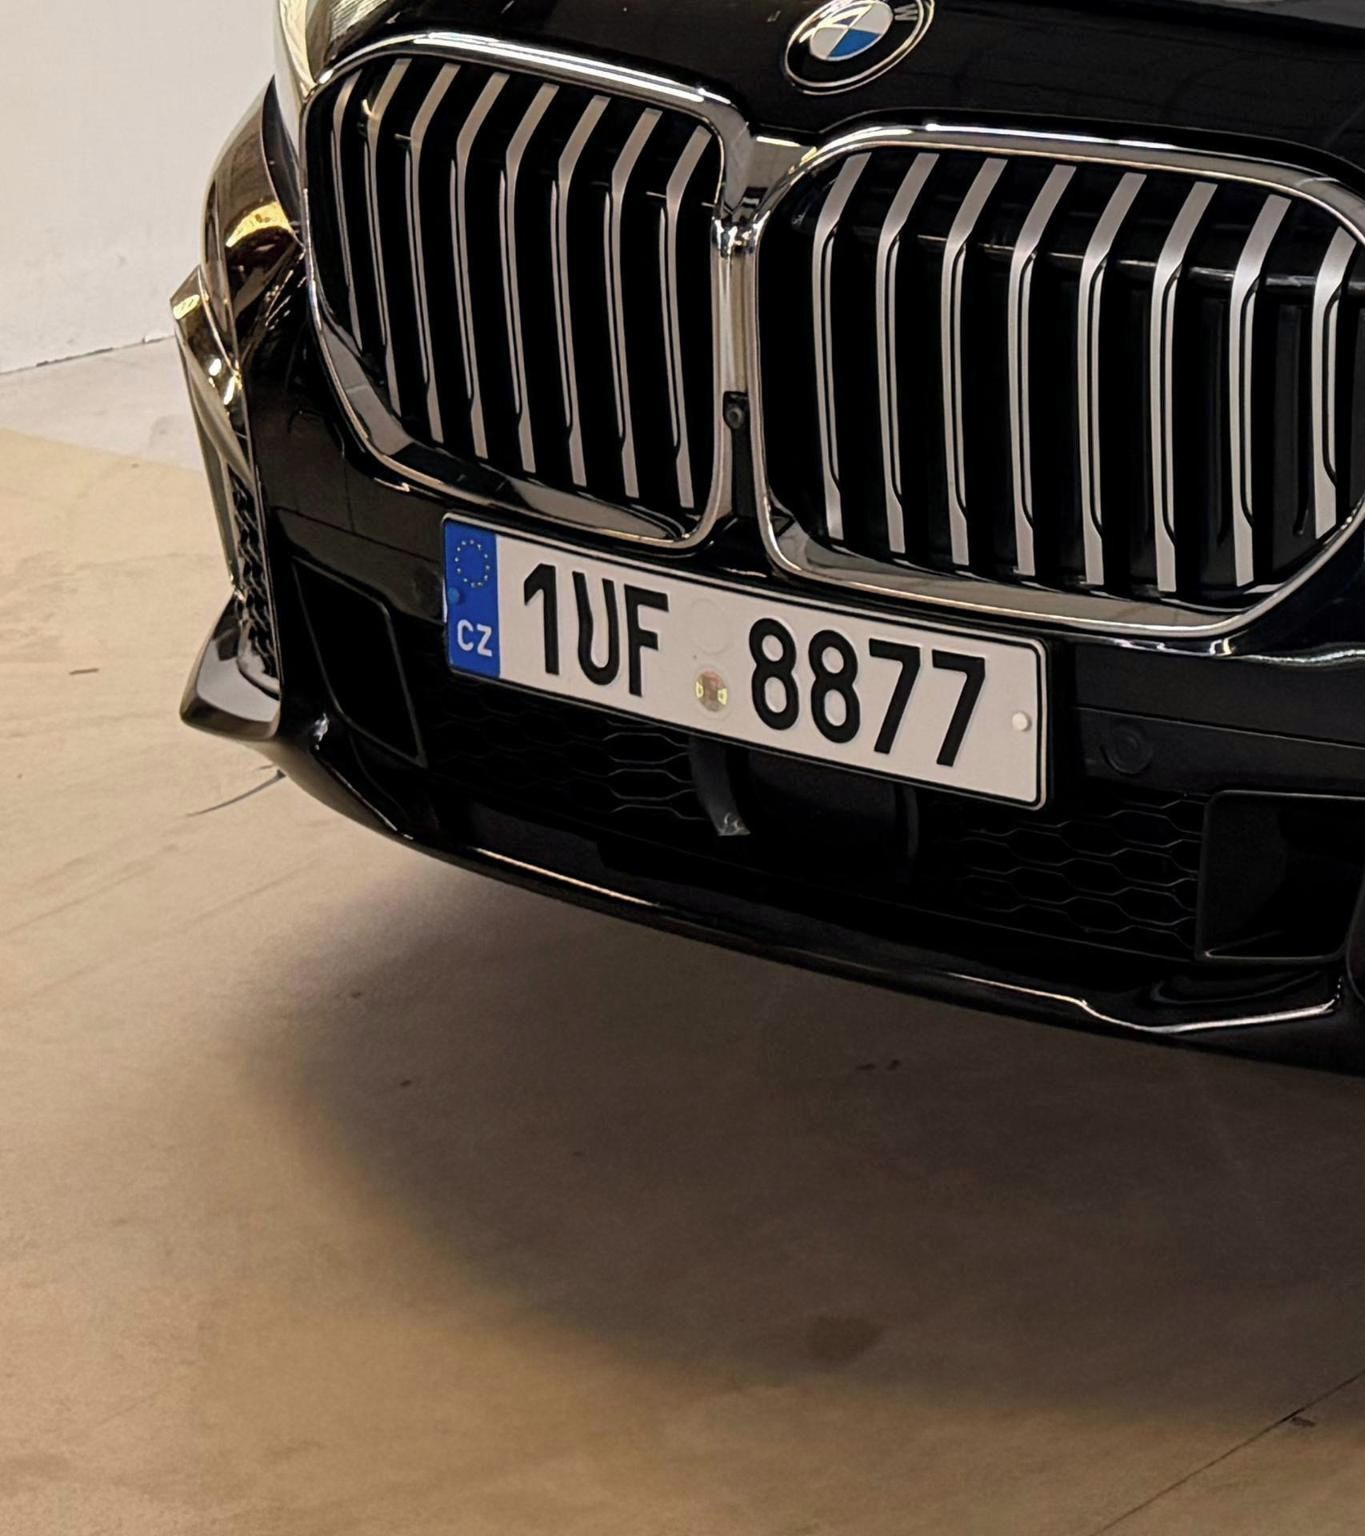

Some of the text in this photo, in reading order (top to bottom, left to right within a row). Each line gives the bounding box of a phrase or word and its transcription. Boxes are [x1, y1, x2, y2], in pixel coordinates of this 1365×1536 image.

[456, 618, 494, 658] CZ
[523, 563, 986, 767] 1UF 8877
